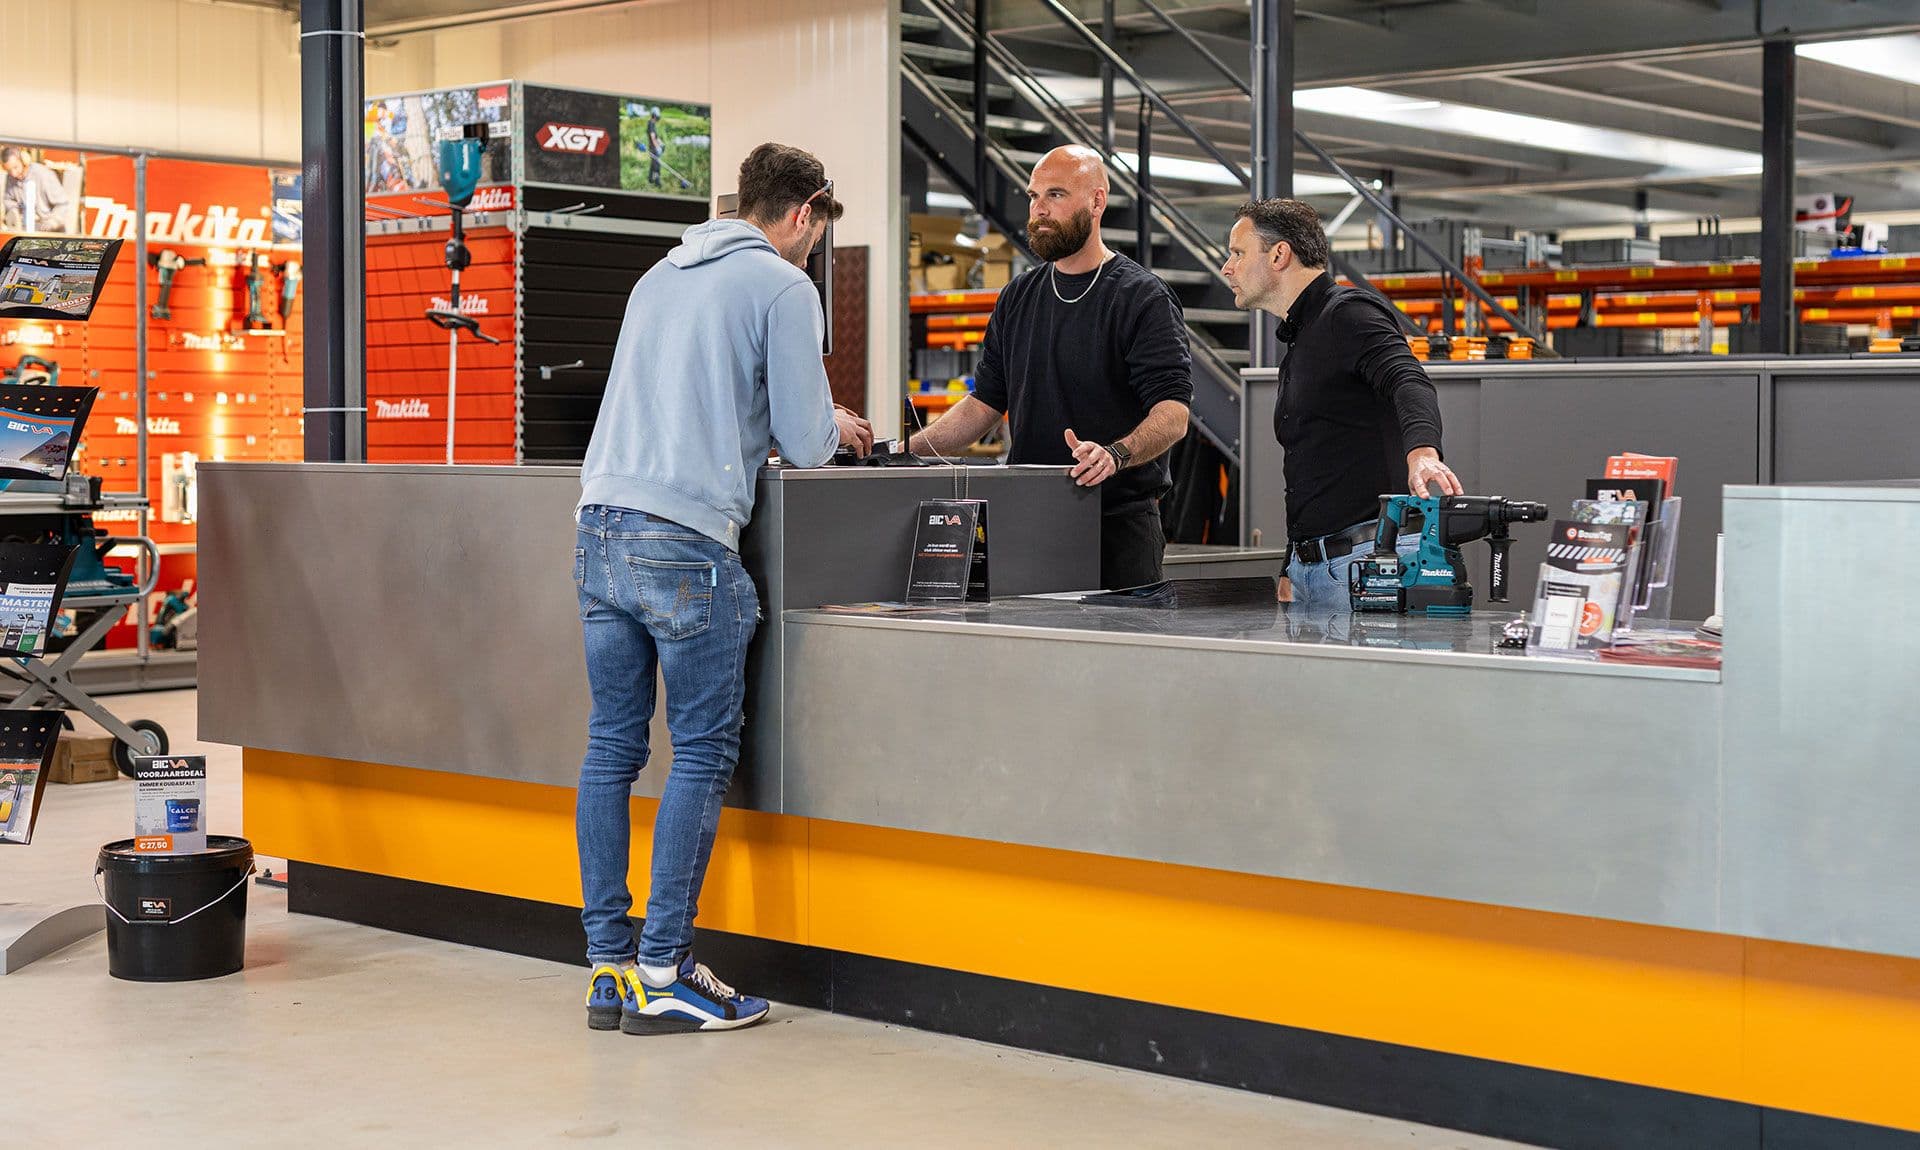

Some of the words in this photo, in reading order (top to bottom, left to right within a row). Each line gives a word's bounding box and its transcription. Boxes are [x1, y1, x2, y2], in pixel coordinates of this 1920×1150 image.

[543, 125, 605, 152] XGT
[465, 188, 512, 209] akita
[137, 770, 204, 778] VOORJAARSDEAL
[594, 986, 616, 1000] 19
